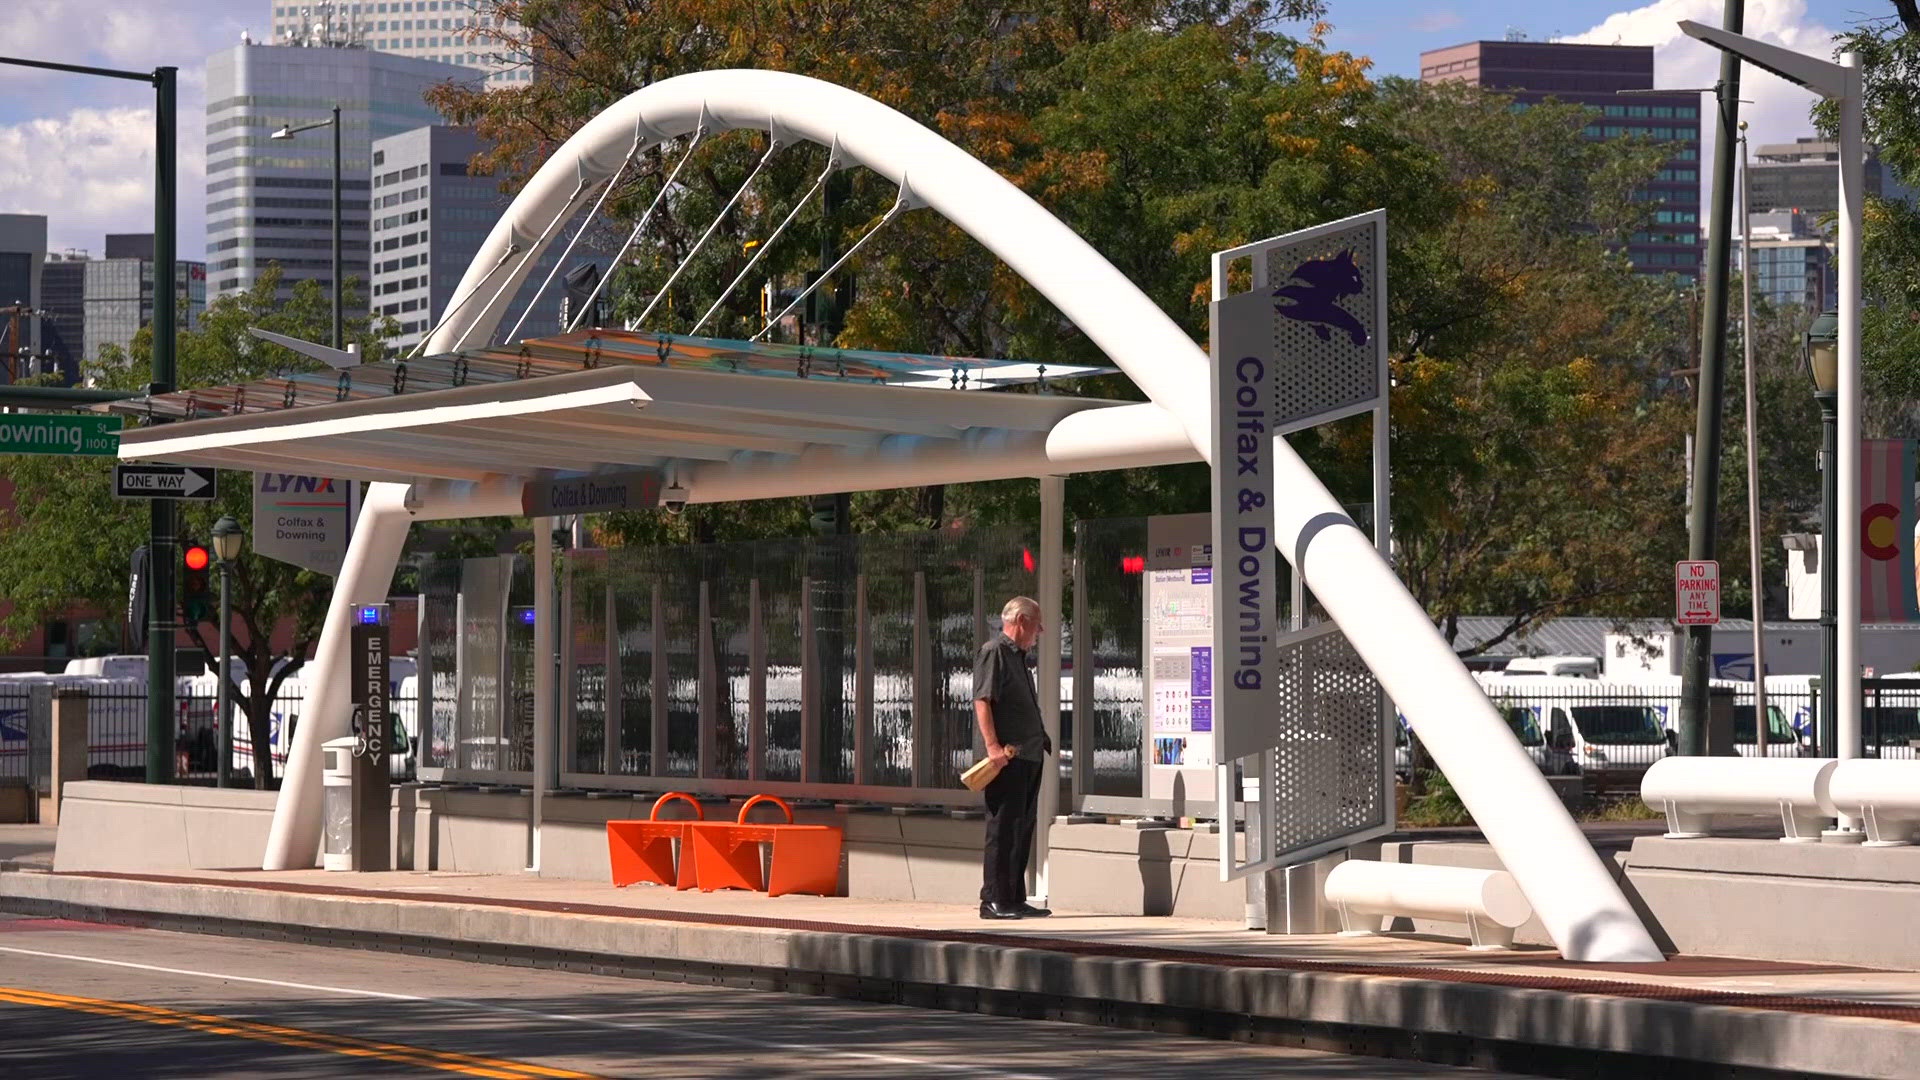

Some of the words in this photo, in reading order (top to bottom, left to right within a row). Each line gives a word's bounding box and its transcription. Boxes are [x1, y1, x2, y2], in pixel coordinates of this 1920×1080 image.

[1235, 356, 1265, 476] Colfax
[97, 423, 107, 433] St
[86, 438, 107, 449] 1100
[111, 439, 117, 449] E
[126, 475, 152, 487] ONE
[157, 476, 184, 488] WAY
[261, 472, 335, 493] LYNX
[551, 485, 579, 508] Colfax
[581, 483, 586, 506] &
[589, 482, 627, 508] Downing
[1237, 487, 1266, 514] &
[277, 517, 313, 527] Colfax
[316, 517, 325, 527] &
[276, 530, 325, 542] Downing
[1690, 565, 1705, 577] NO
[1680, 579, 1716, 591] PARKING
[1689, 592, 1706, 600] ANY
[1234, 527, 1268, 690] Downing
[1688, 601, 1708, 609] TIME
[367, 637, 382, 766] EMERGENCY
